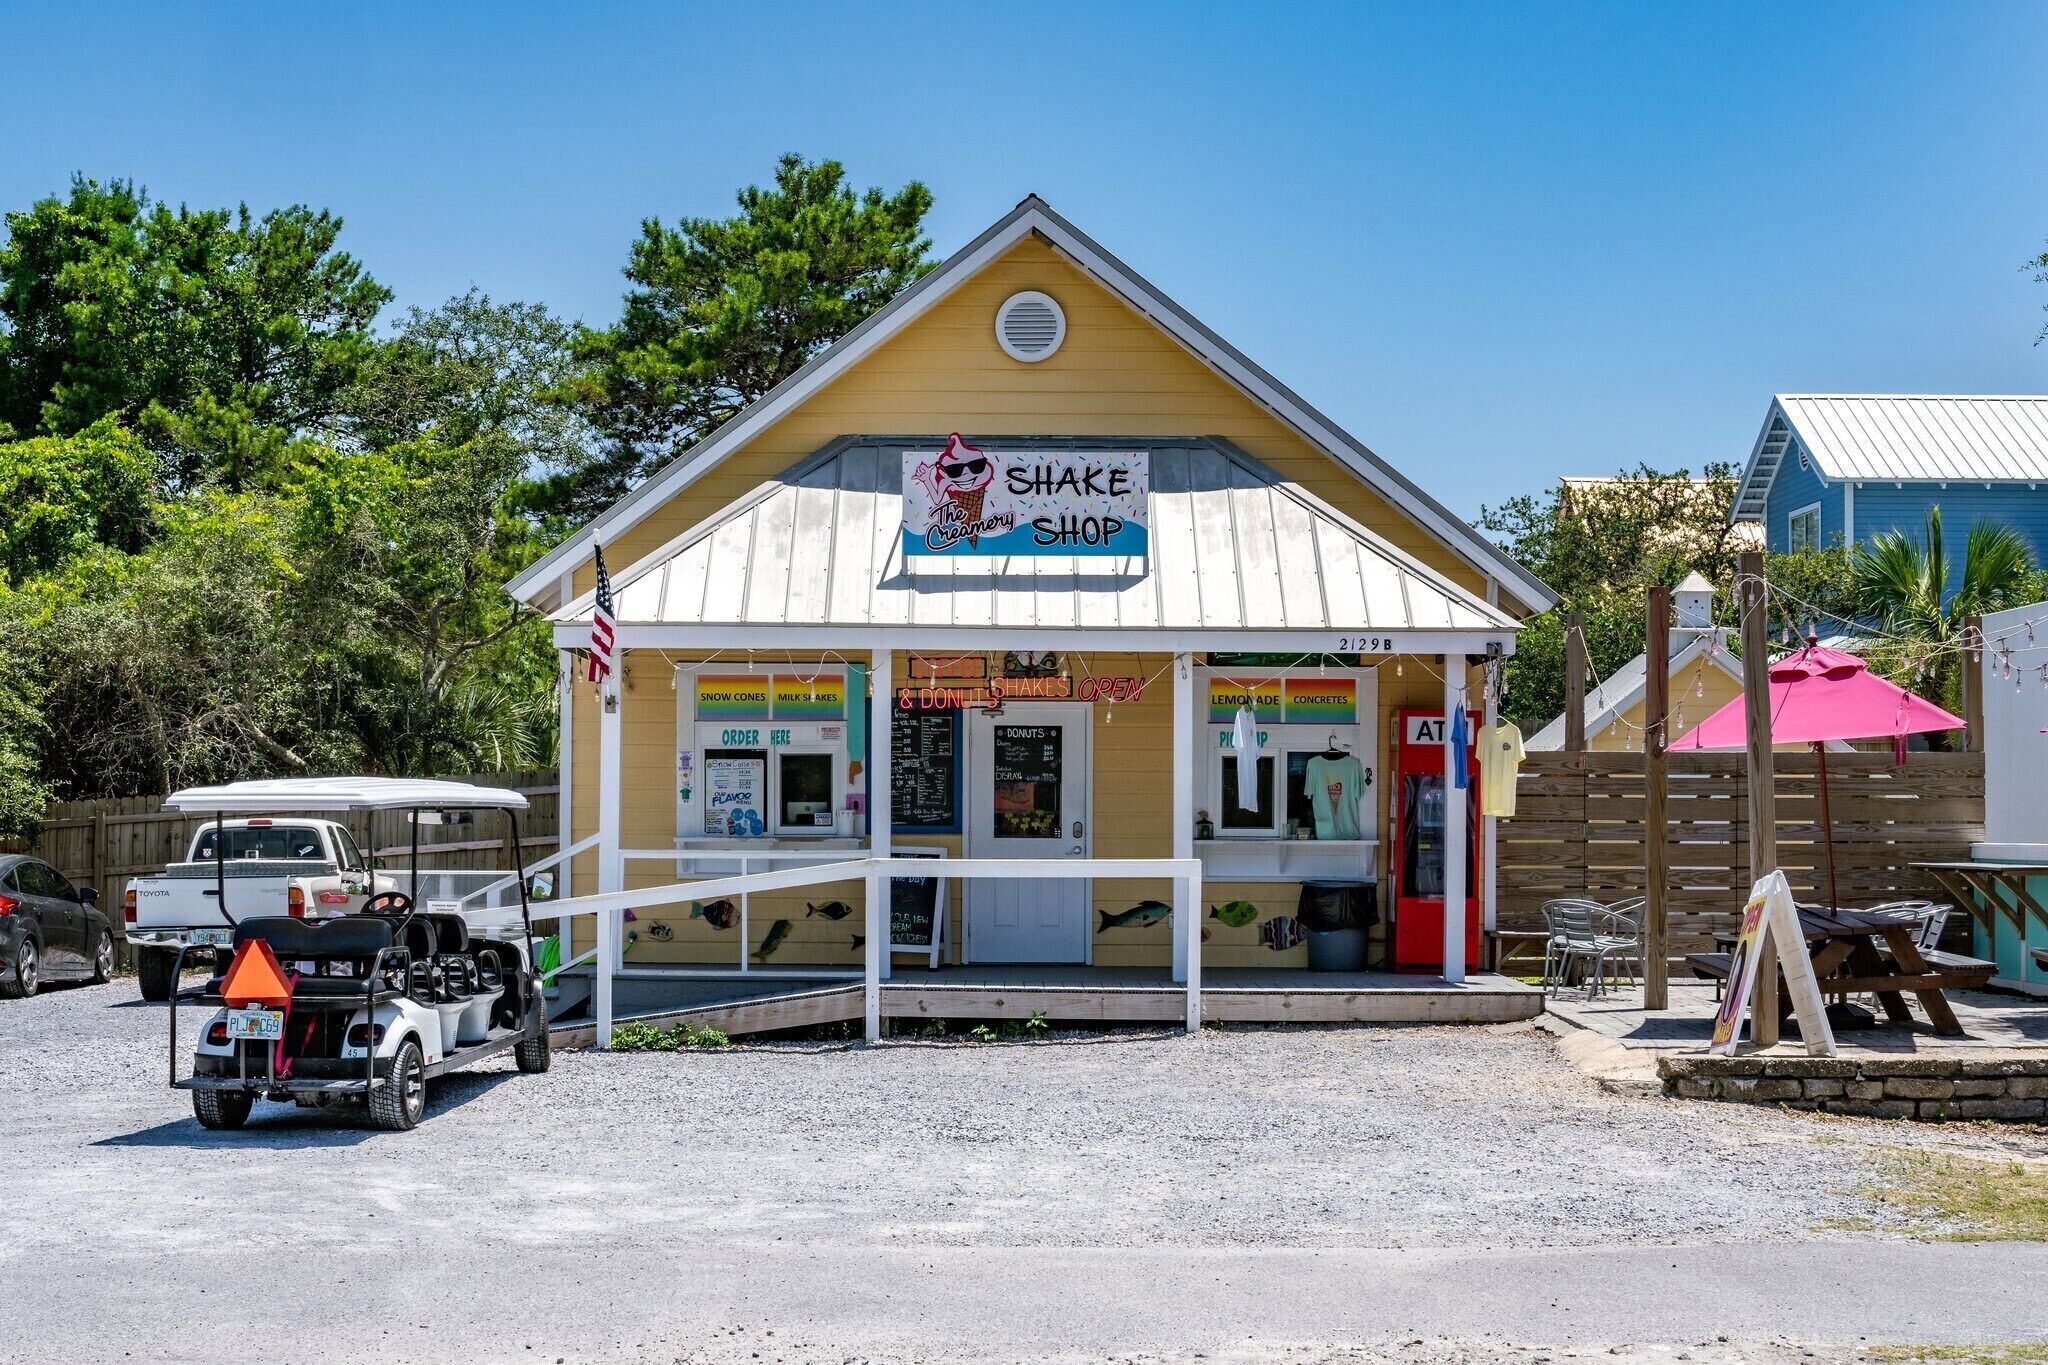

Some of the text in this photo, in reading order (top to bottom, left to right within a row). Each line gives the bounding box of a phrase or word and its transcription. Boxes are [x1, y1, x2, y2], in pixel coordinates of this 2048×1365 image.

[1006, 465, 1132, 496] SHAKE
[930, 501, 967, 527] The
[926, 511, 1016, 549] Creamery
[1032, 515, 1122, 546] SHOP
[995, 677, 1069, 698] SHAKES
[1079, 678, 1147, 702] OPEN
[701, 693, 766, 701] SNOW CONES
[778, 694, 800, 702] MILK
[900, 688, 999, 709] & DONUTS
[1293, 695, 1348, 704] CONCRETES
[722, 729, 791, 746] ORDER HERE
[1007, 728, 1045, 738] DONUTS
[712, 792, 752, 807] FLAVOR
[230, 1017, 279, 1032] PLJ C69
[347, 1049, 358, 1059] 45
